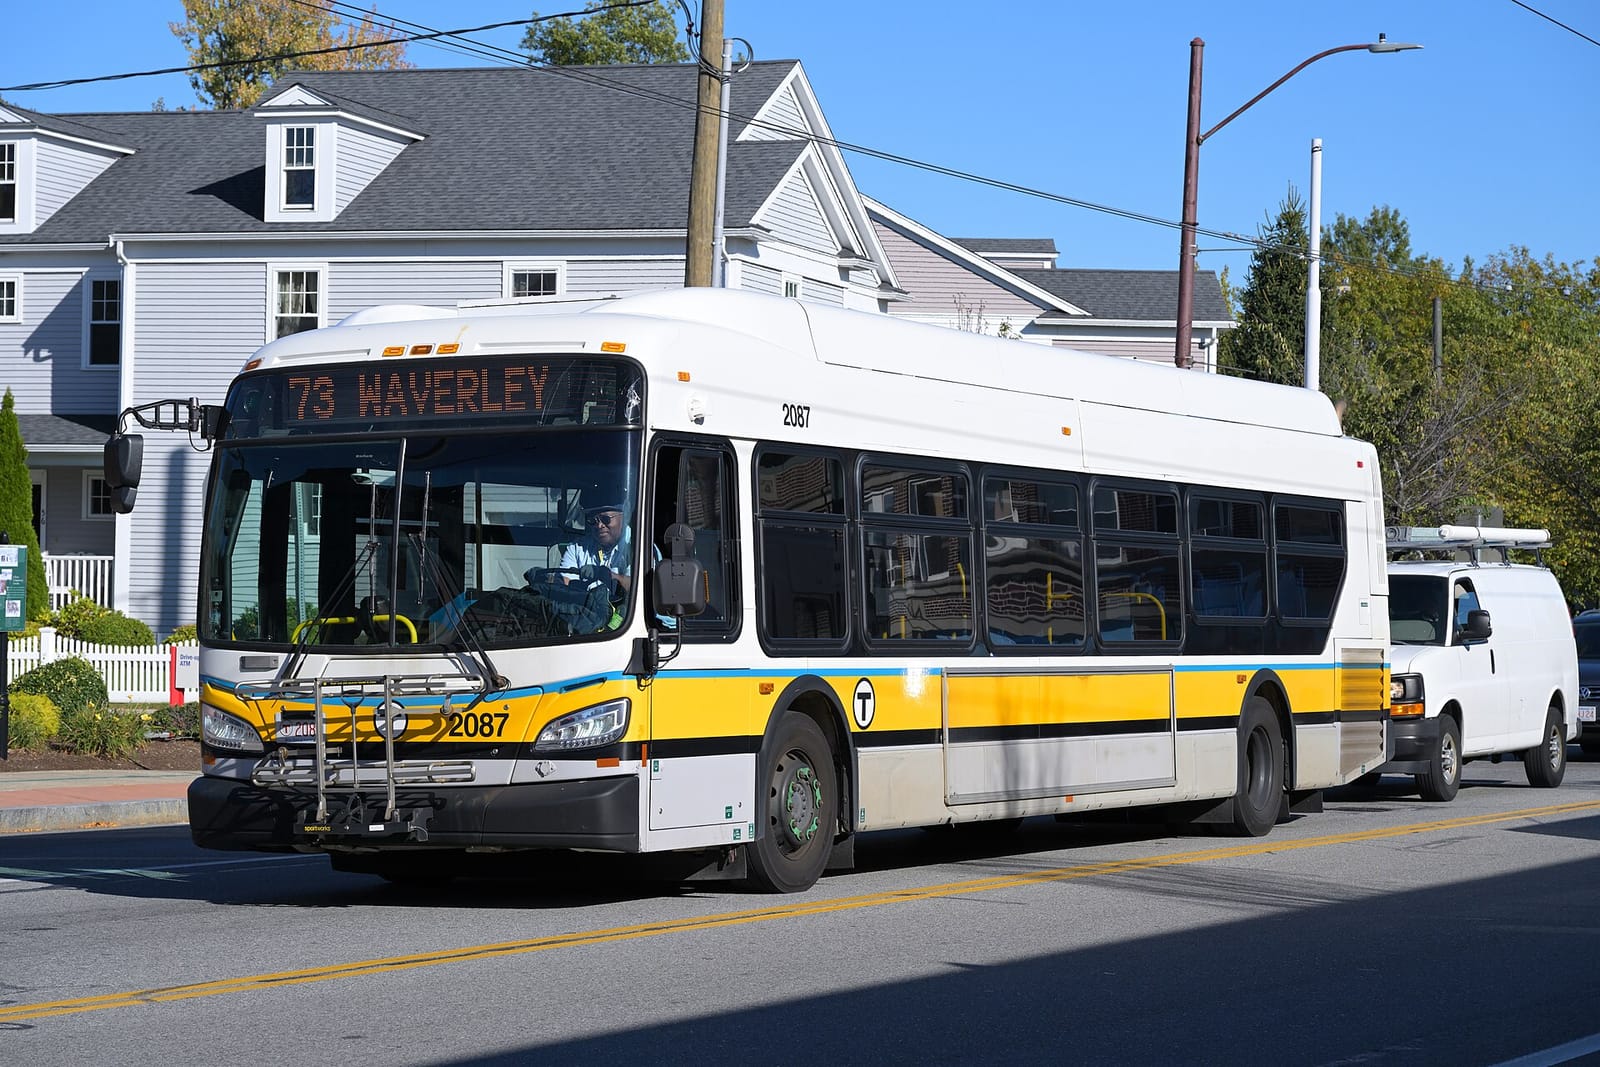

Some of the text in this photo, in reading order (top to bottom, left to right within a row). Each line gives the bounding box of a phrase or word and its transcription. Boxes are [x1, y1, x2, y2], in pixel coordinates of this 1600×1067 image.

[289, 365, 549, 420] 73 WAVERLEY
[782, 403, 810, 428] 2087
[294, 722, 317, 737] 208
[448, 712, 510, 738] 2087
